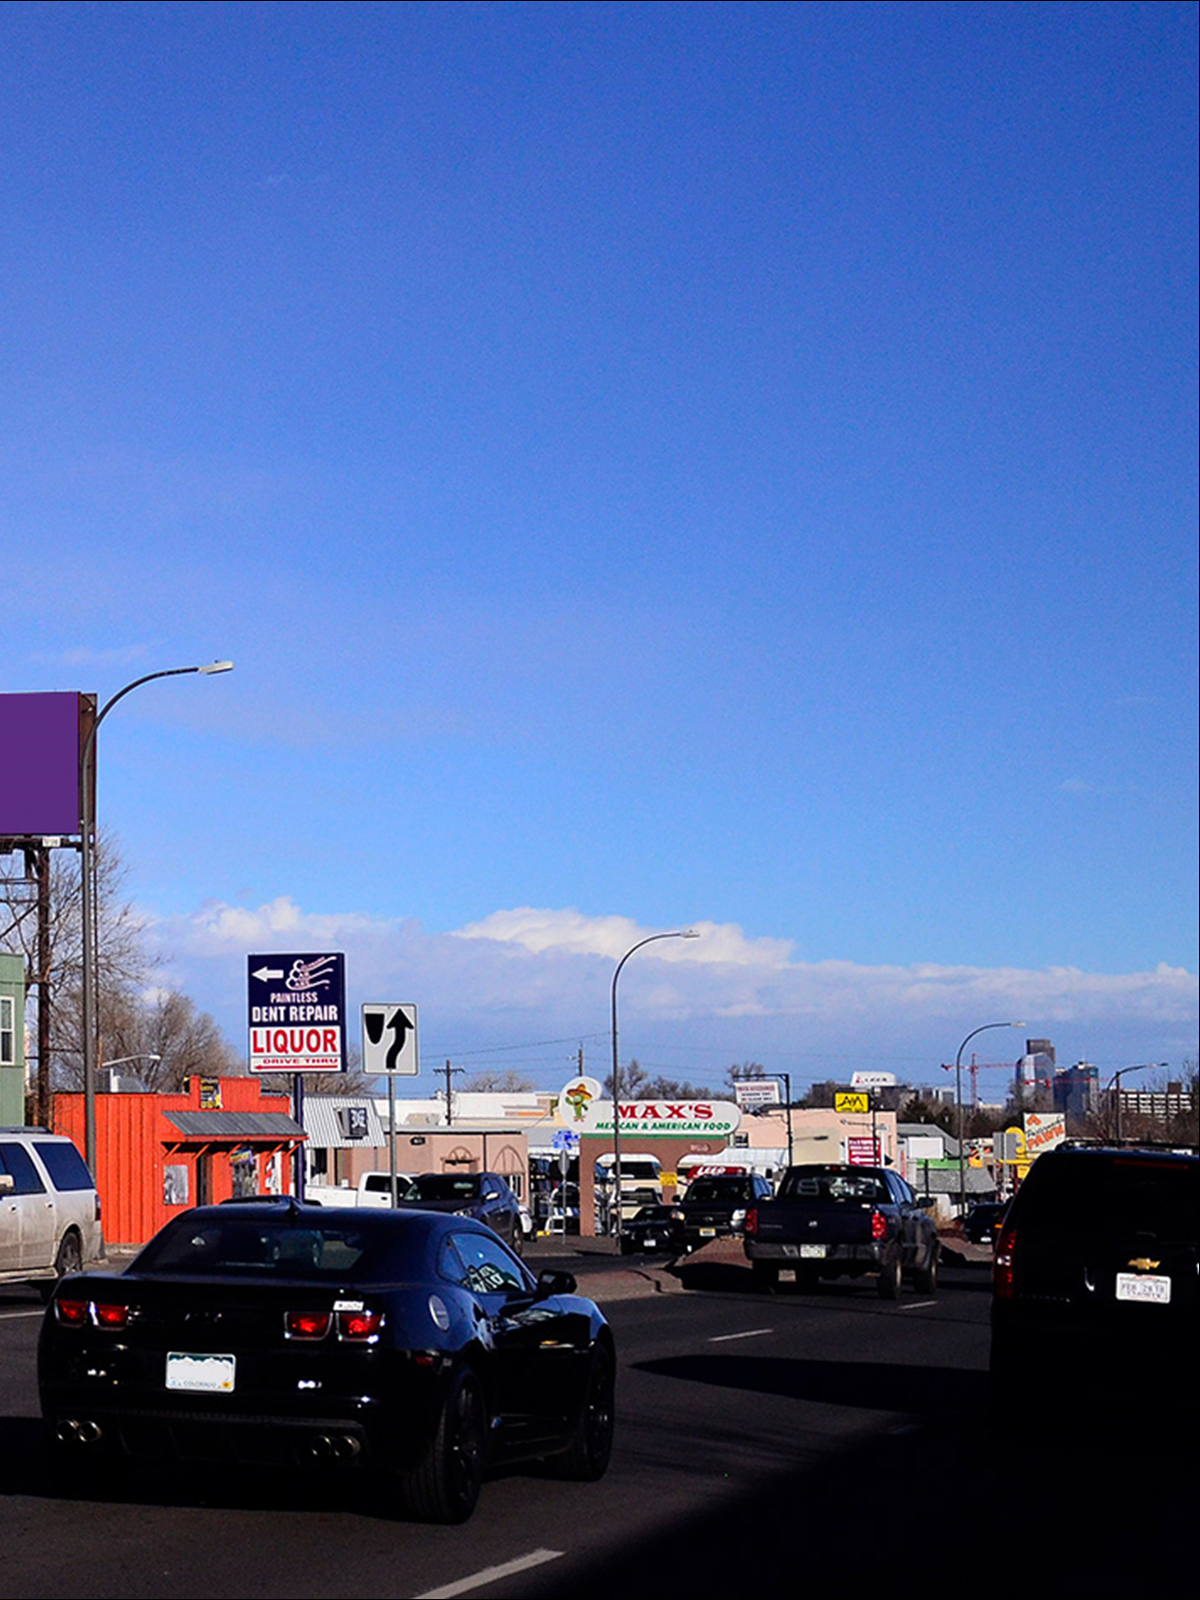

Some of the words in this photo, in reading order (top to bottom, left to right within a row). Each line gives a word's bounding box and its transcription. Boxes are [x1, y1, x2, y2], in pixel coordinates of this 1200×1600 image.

[270, 992, 318, 1003] PAINTLESS
[252, 1006, 286, 1022] DENT
[289, 1005, 338, 1021] REPAIR
[252, 1029, 338, 1054] LIQUOR
[612, 1104, 714, 1120] MAX'S
[595, 1122, 639, 1130] MEXCAN
[641, 1122, 649, 1130] &
[651, 1122, 700, 1130] AMERICAN
[703, 1122, 731, 1130] FOOD
[1027, 1123, 1065, 1150] PAWN
